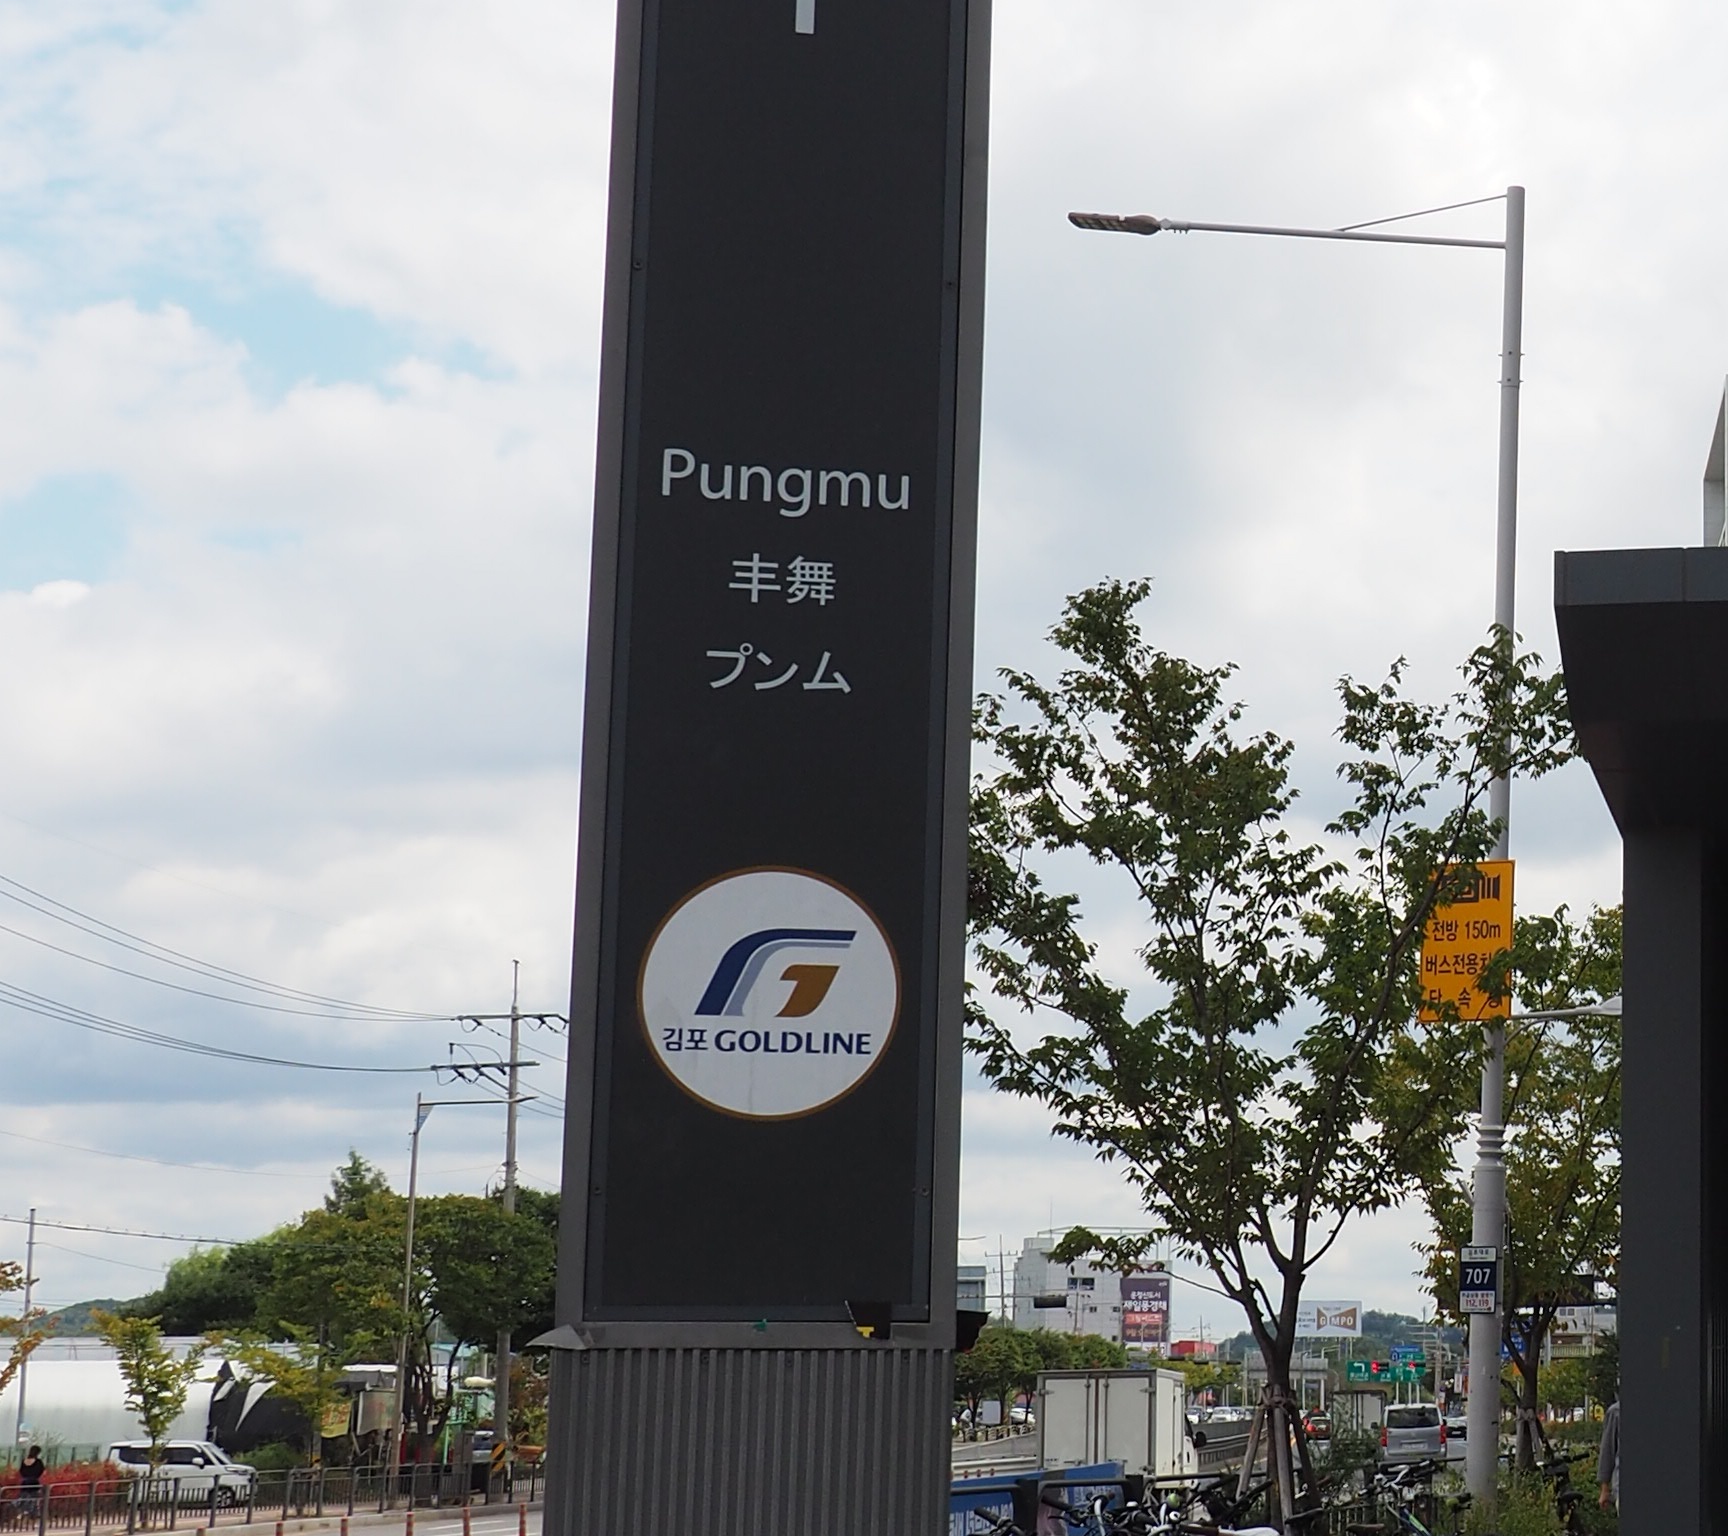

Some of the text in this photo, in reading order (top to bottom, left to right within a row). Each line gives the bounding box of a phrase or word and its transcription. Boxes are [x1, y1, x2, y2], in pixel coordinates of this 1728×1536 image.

[660, 446, 912, 518] Pungmu
[727, 552, 838, 607] 丰舞
[705, 641, 852, 696] プンム
[1431, 919, 1501, 942] 전방 150m
[1425, 952, 1494, 976] 버스전용차
[662, 1027, 872, 1055] 김포 GOLDLINE
[1465, 1268, 1491, 1285] 707
